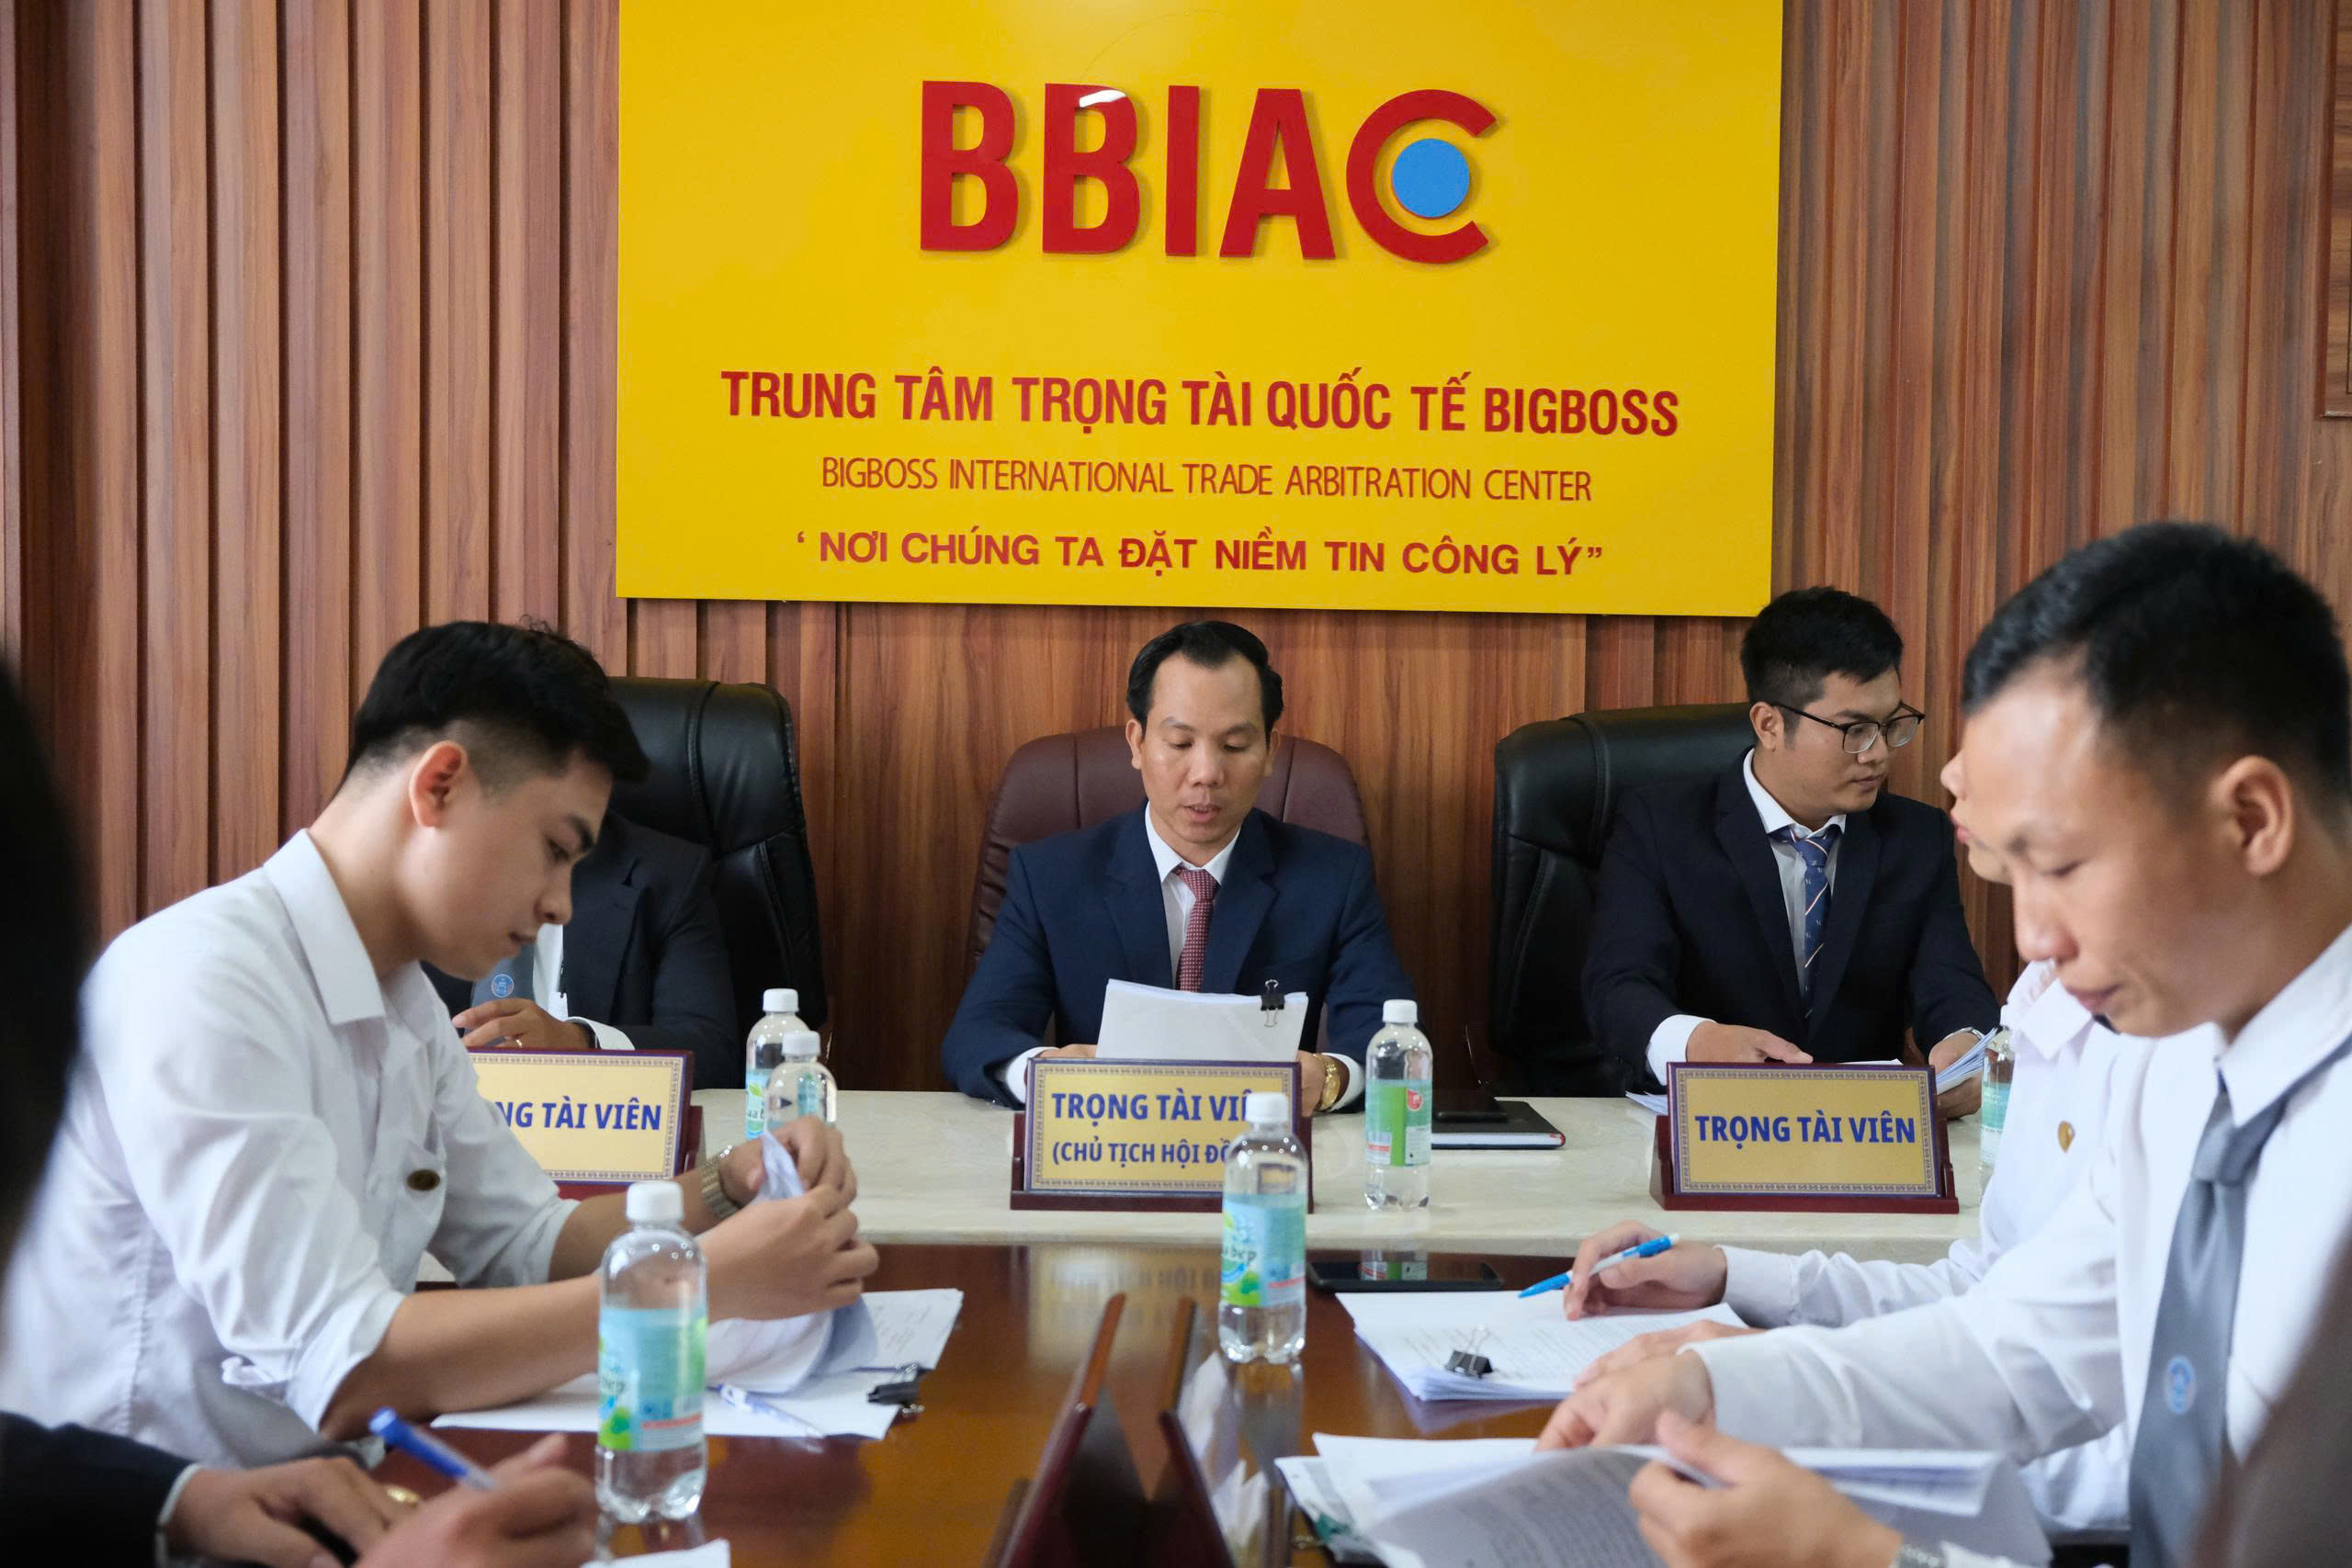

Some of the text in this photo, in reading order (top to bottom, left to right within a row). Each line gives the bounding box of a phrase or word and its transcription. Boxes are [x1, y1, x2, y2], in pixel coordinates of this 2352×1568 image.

[920, 80, 1498, 266] BBIAC
[720, 366, 1679, 437] TRUNG TÂM TRỌNG TÀI QUỐC TẾ BIGBOSS
[822, 457, 1592, 502] BIGBOSS INTERNATIONAL TRADE ARBITRATION CENTER
[820, 530, 888, 563] NƠI
[901, 525, 1039, 566] CHÚNG
[1055, 536, 1104, 567] TA
[1117, 529, 1198, 577] ĐẶT
[1215, 525, 1306, 570] NIỀM
[1323, 541, 1385, 572] TIN
[1402, 535, 1519, 575] CÔNG
[542, 1095, 588, 1129] TÀI
[595, 1097, 662, 1131] VIÊN
[1051, 1092, 1148, 1127] TRỌNG
[1156, 1088, 1203, 1121] TÀI
[1694, 1109, 1916, 1150] TRỌNG TÀI VIÊN
[1052, 1135, 1102, 1166] (CHỦ
[1108, 1143, 1155, 1168] TỊCH
[1161, 1139, 1201, 1169] HỘI
